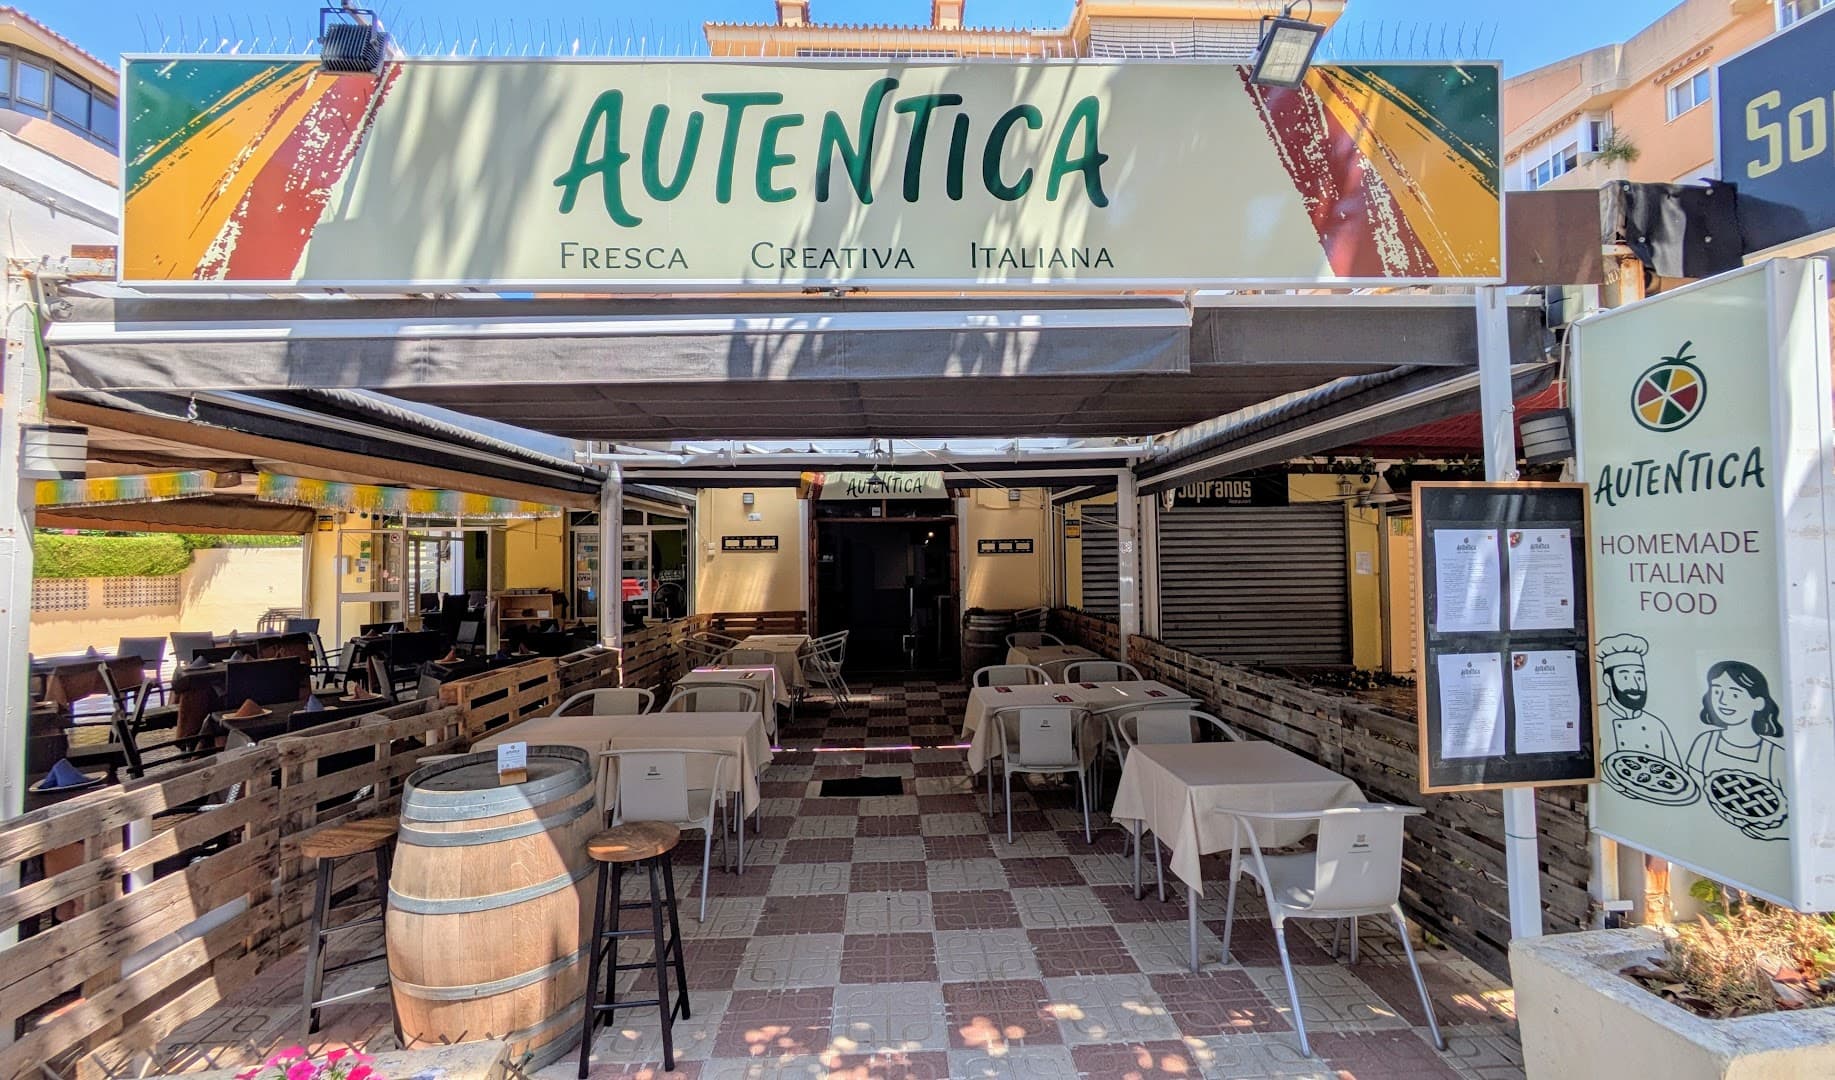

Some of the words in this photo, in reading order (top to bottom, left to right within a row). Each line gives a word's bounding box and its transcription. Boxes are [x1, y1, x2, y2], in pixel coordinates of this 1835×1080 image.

[1746, 90, 1835, 179] So
[553, 77, 1110, 228] AUTENTICA
[560, 241, 689, 270] FRESCA
[750, 241, 915, 270] CREATIVA
[970, 241, 1115, 270] ITALIANA
[1594, 446, 1766, 507] AUTENTICA
[1600, 530, 1760, 556] HOMEMADE
[1629, 562, 1725, 585] ITALIAN
[1639, 591, 1718, 616] FOOD
